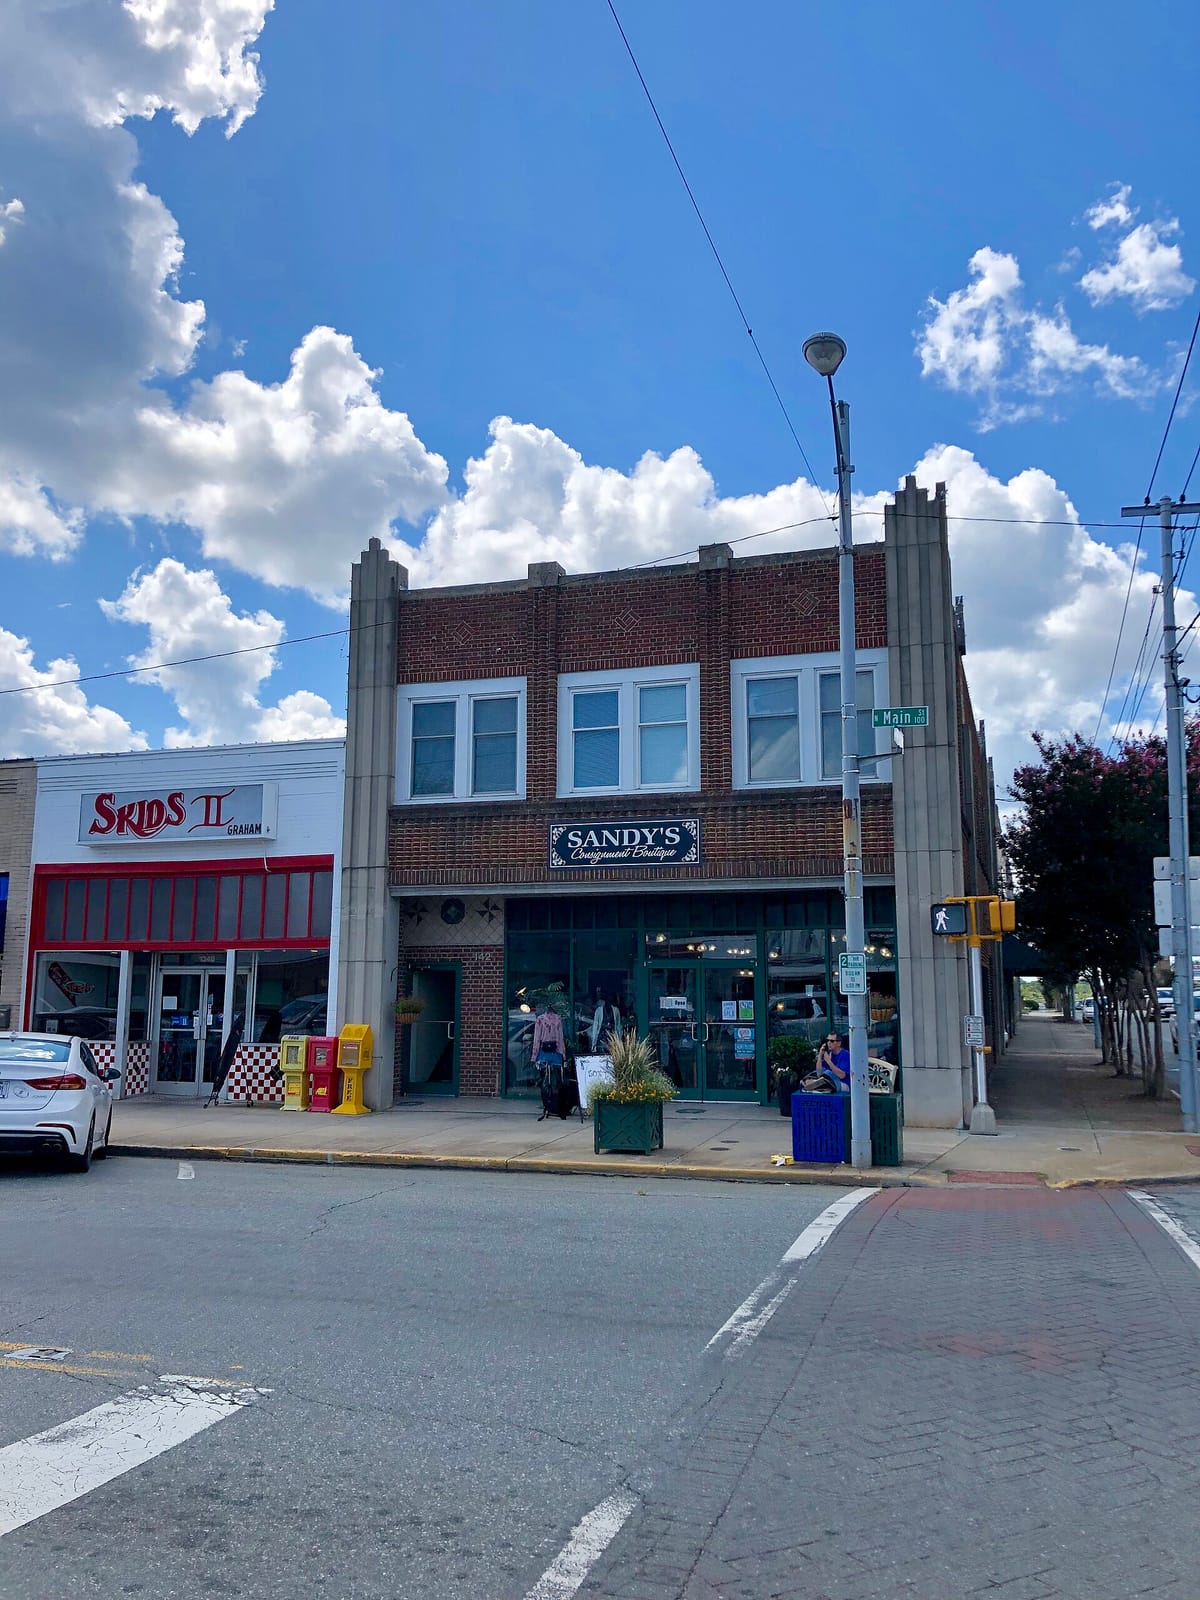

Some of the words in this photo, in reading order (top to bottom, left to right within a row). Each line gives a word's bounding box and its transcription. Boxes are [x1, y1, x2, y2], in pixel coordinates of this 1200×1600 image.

[883, 710, 911, 725] Main
[88, 791, 187, 839] SKIDS
[188, 788, 236, 833] II
[227, 823, 262, 836] GRAHAM
[567, 827, 681, 848] SANDY'S
[570, 847, 632, 864] Consignment
[632, 845, 677, 861] Boutique
[841, 956, 847, 967] 2
